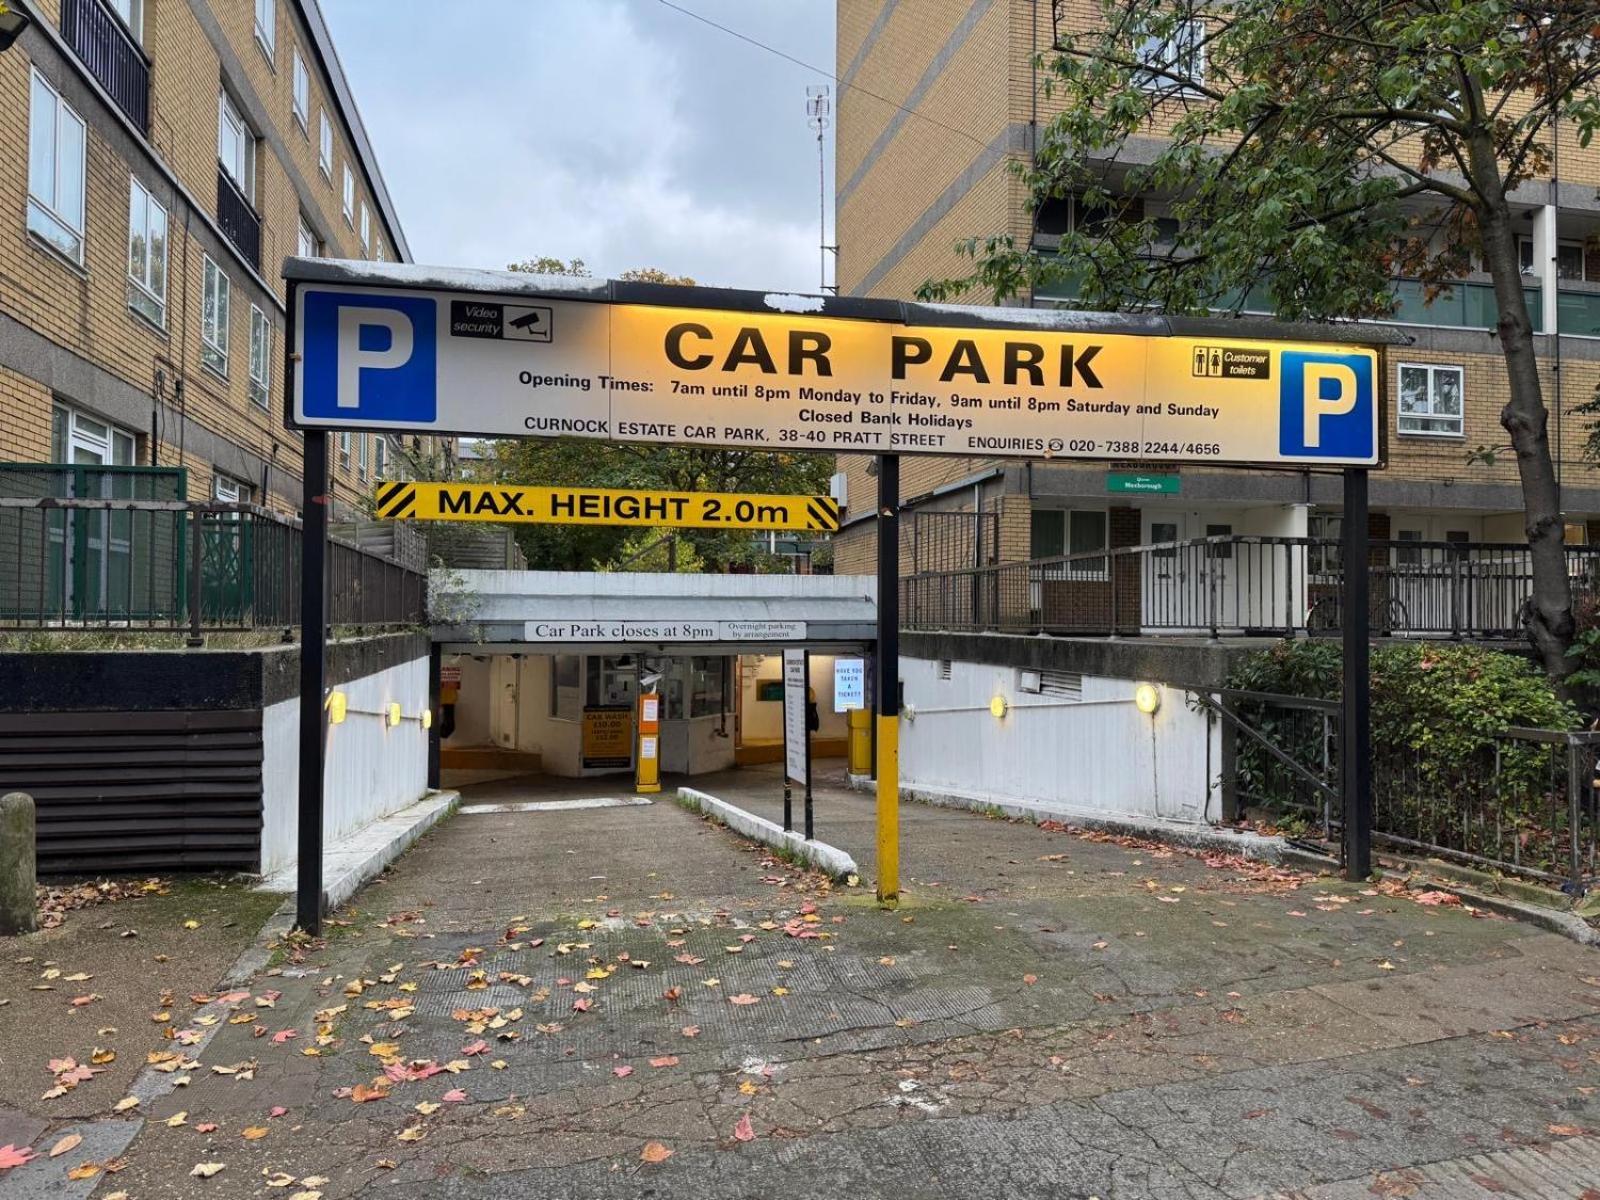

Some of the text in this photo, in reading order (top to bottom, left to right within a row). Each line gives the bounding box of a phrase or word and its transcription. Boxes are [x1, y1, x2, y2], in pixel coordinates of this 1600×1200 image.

[465, 306, 498, 319] Video
[453, 322, 500, 336] security
[337, 305, 414, 408] P
[664, 322, 1104, 389] CAR PARK
[1224, 351, 1268, 363] Customer
[1229, 365, 1257, 375] toilets
[519, 371, 1220, 419] Opening Times: 7am until 8pm Monday to Friday, 9am until 8pm Saturday and Sunday
[1303, 362, 1358, 447] P
[799, 409, 973, 430] Closed Bank Holidays
[524, 416, 609, 433] CURNOCK
[618, 421, 676, 437] ESTATE
[684, 425, 716, 438] CAR
[724, 427, 770, 442] PARK,
[779, 429, 826, 442] 38-40
[833, 431, 882, 444] PRATT
[890, 433, 945, 446] STREET
[968, 436, 1044, 451] ENQUIRIES
[1144, 443, 1220, 455] 2244/4656
[1125, 482, 1162, 490] Mexborough
[437, 490, 789, 524] MAX. HEIGHT 2.0m
[535, 624, 714, 639] Car Park closes at 8pm
[728, 622, 797, 631] Overnight parking
[744, 631, 790, 639] arrangement
